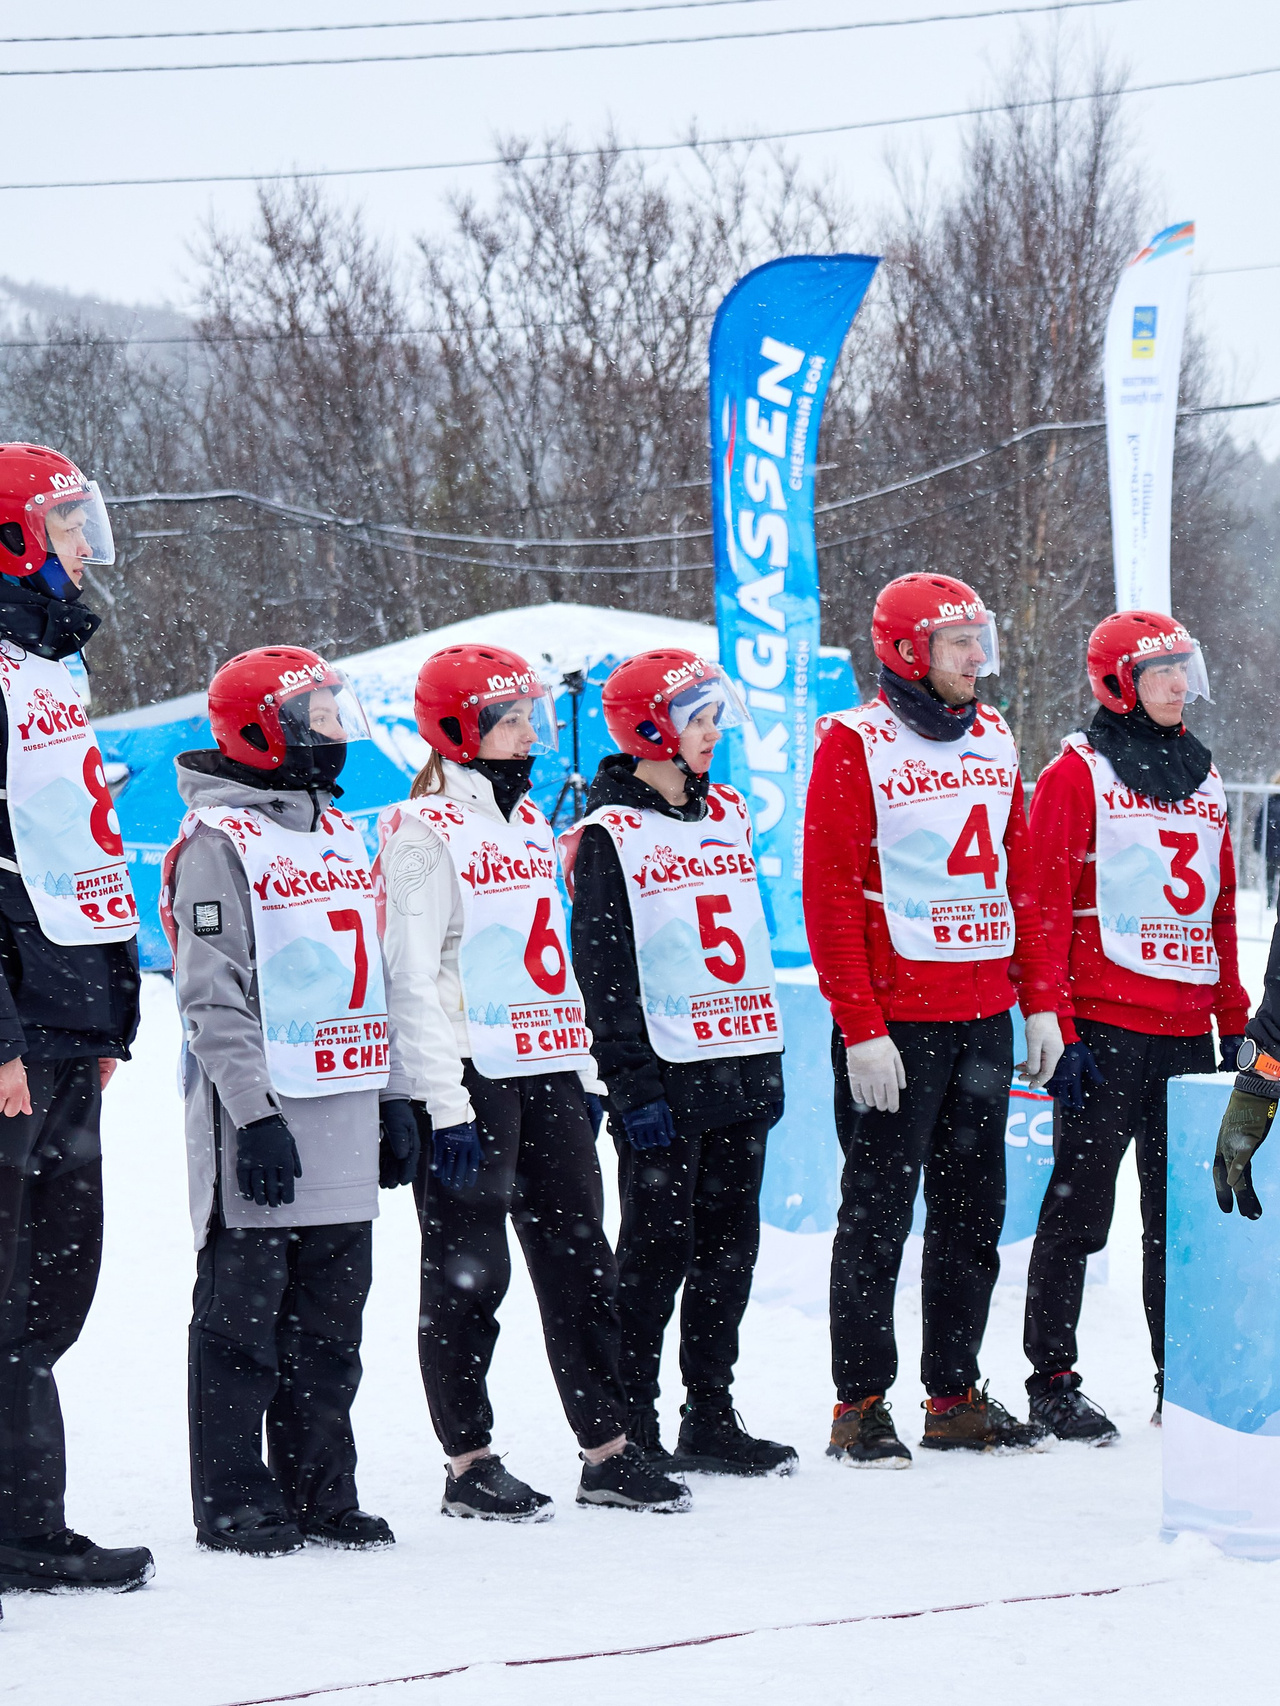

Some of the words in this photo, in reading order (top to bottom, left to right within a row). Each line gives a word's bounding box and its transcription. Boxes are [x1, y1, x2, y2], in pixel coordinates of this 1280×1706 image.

[802, 355, 826, 395] БОЙ
[735, 335, 806, 878] UKIGASSEN
[794, 639, 810, 706] REGION
[83, 745, 125, 857] 8
[947, 804, 999, 890] 4
[253, 862, 374, 901] YUKIGASSE
[1158, 829, 1206, 916] 3
[76, 877, 100, 892] ДЛЯ
[77, 890, 98, 901] КТО
[98, 884, 124, 897] ЗНАЕТ
[80, 902, 105, 923] В
[932, 907, 953, 915] ДЛЯ
[695, 894, 746, 985] 5
[933, 925, 951, 943] В
[523, 897, 567, 995] 6
[1141, 942, 1157, 960] В
[326, 908, 368, 1010] 7
[691, 1002, 711, 1011] ДЛЯ
[691, 1011, 708, 1019] КТО
[708, 1007, 734, 1017] ЗНАЕТ
[734, 993, 774, 1011] ТОЛК
[511, 1011, 532, 1022] ДЛЯ
[512, 1020, 530, 1029] КТО
[530, 1019, 552, 1028] ЗНАЕТ
[693, 1022, 713, 1040] В
[718, 1013, 778, 1037] СНЕГЕ
[315, 1027, 339, 1039] ДЛЯ
[315, 1038, 334, 1047] КТО
[335, 1034, 361, 1044] ЗНАЕТ
[515, 1033, 533, 1055] В
[538, 1028, 588, 1052] СНЕГЕ
[315, 1050, 336, 1073] В
